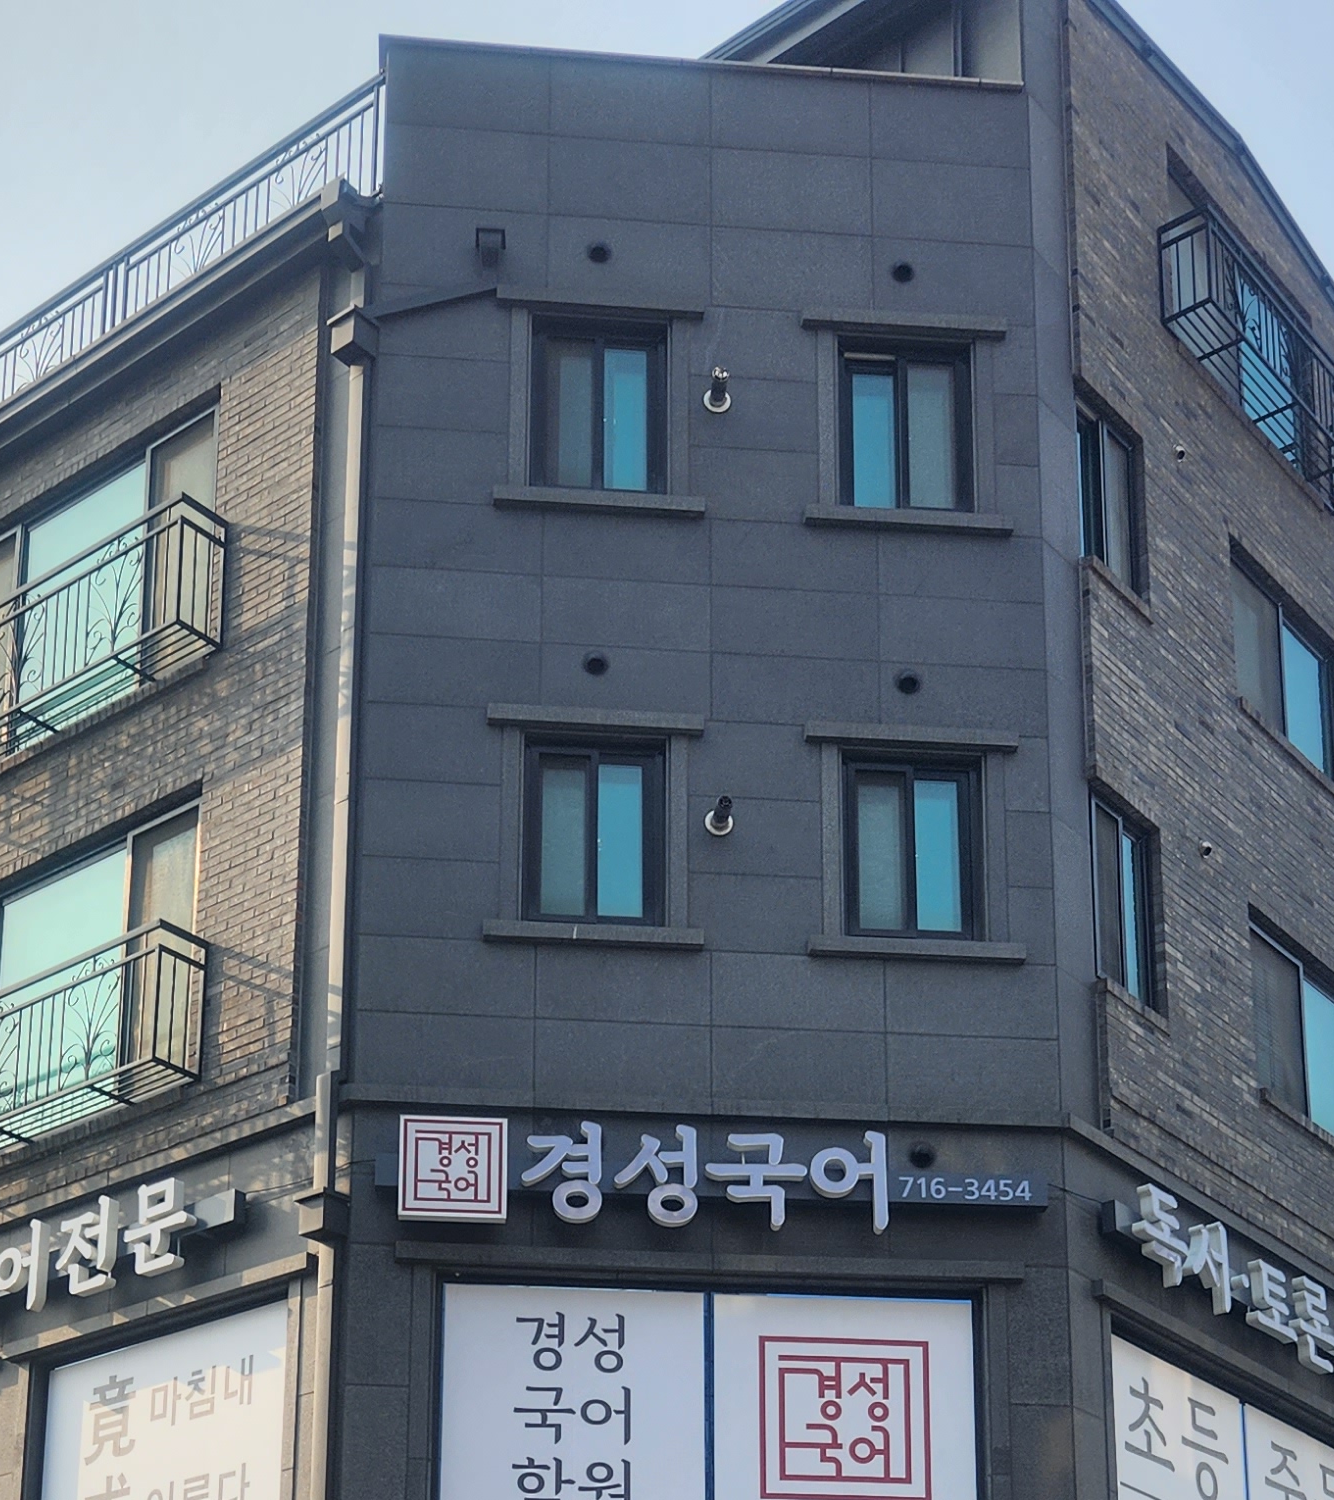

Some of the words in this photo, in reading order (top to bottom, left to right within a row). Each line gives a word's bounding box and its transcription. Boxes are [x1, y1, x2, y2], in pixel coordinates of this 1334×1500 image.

[521, 1120, 891, 1236] 경성국어
[898, 1174, 1033, 1204] 716-3454
[515, 1310, 627, 1375] 경성
[149, 1353, 255, 1429] 마침내
[512, 1385, 633, 1447] 국어
